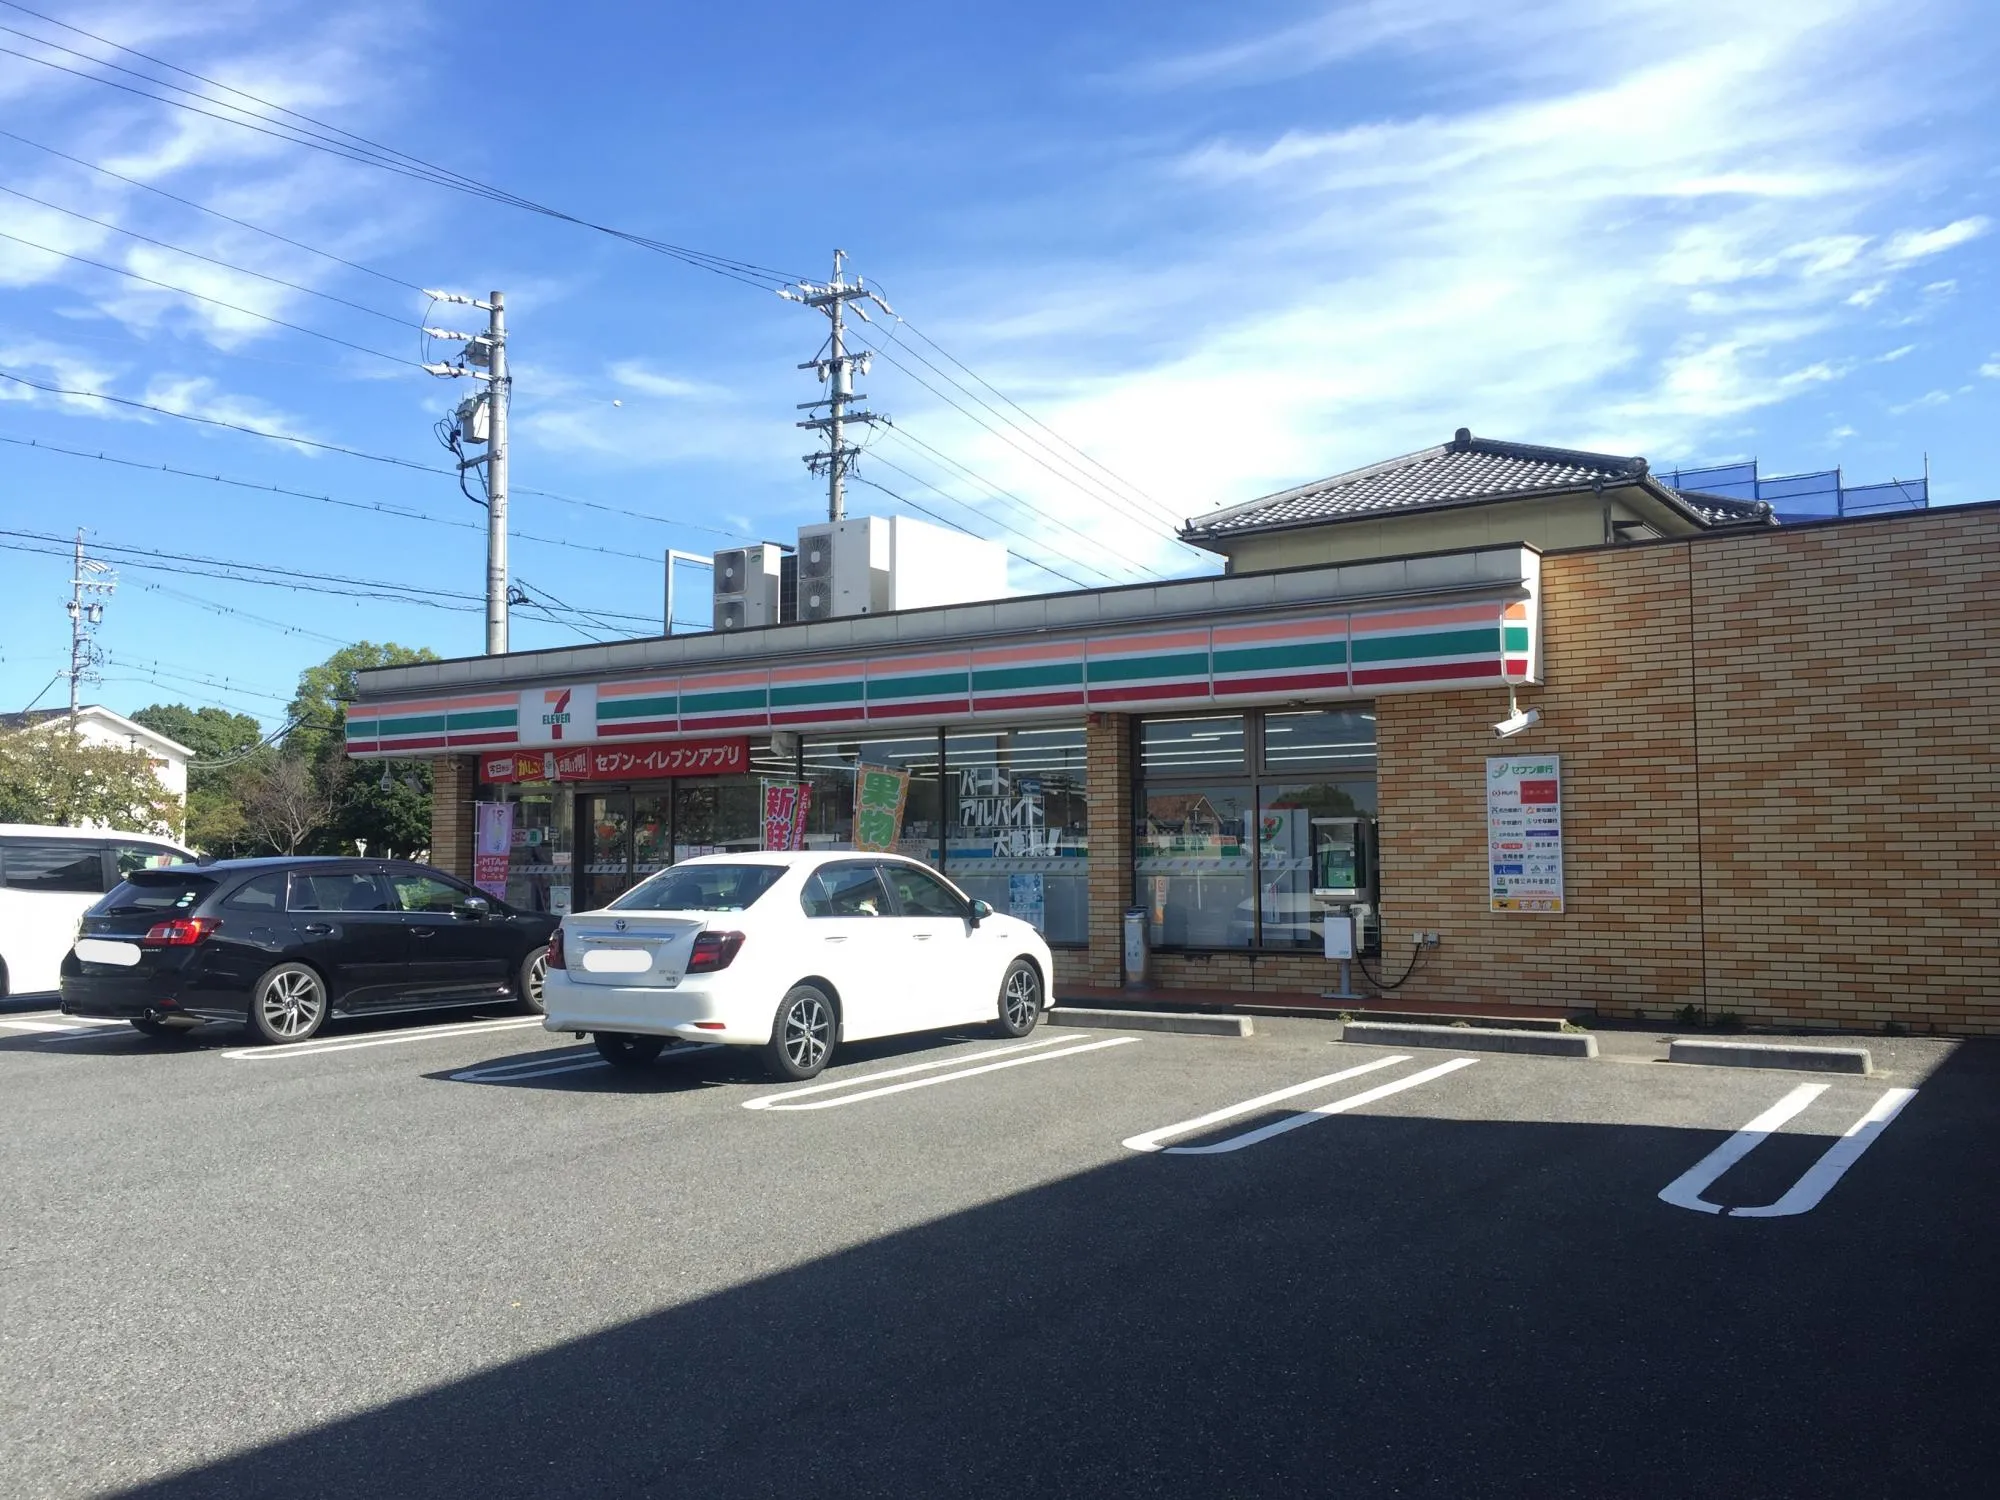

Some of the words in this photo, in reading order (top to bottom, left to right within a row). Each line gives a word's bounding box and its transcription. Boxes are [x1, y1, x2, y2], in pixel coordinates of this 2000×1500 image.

[544, 688, 571, 740] 7
[595, 745, 740, 773] セブン-イレブンアプリ
[1511, 765, 1554, 775] セブン銀行
[961, 768, 1009, 796] パート
[766, 786, 795, 851] 新鮮
[859, 771, 901, 847] 果物
[961, 797, 1044, 827] アルバイト
